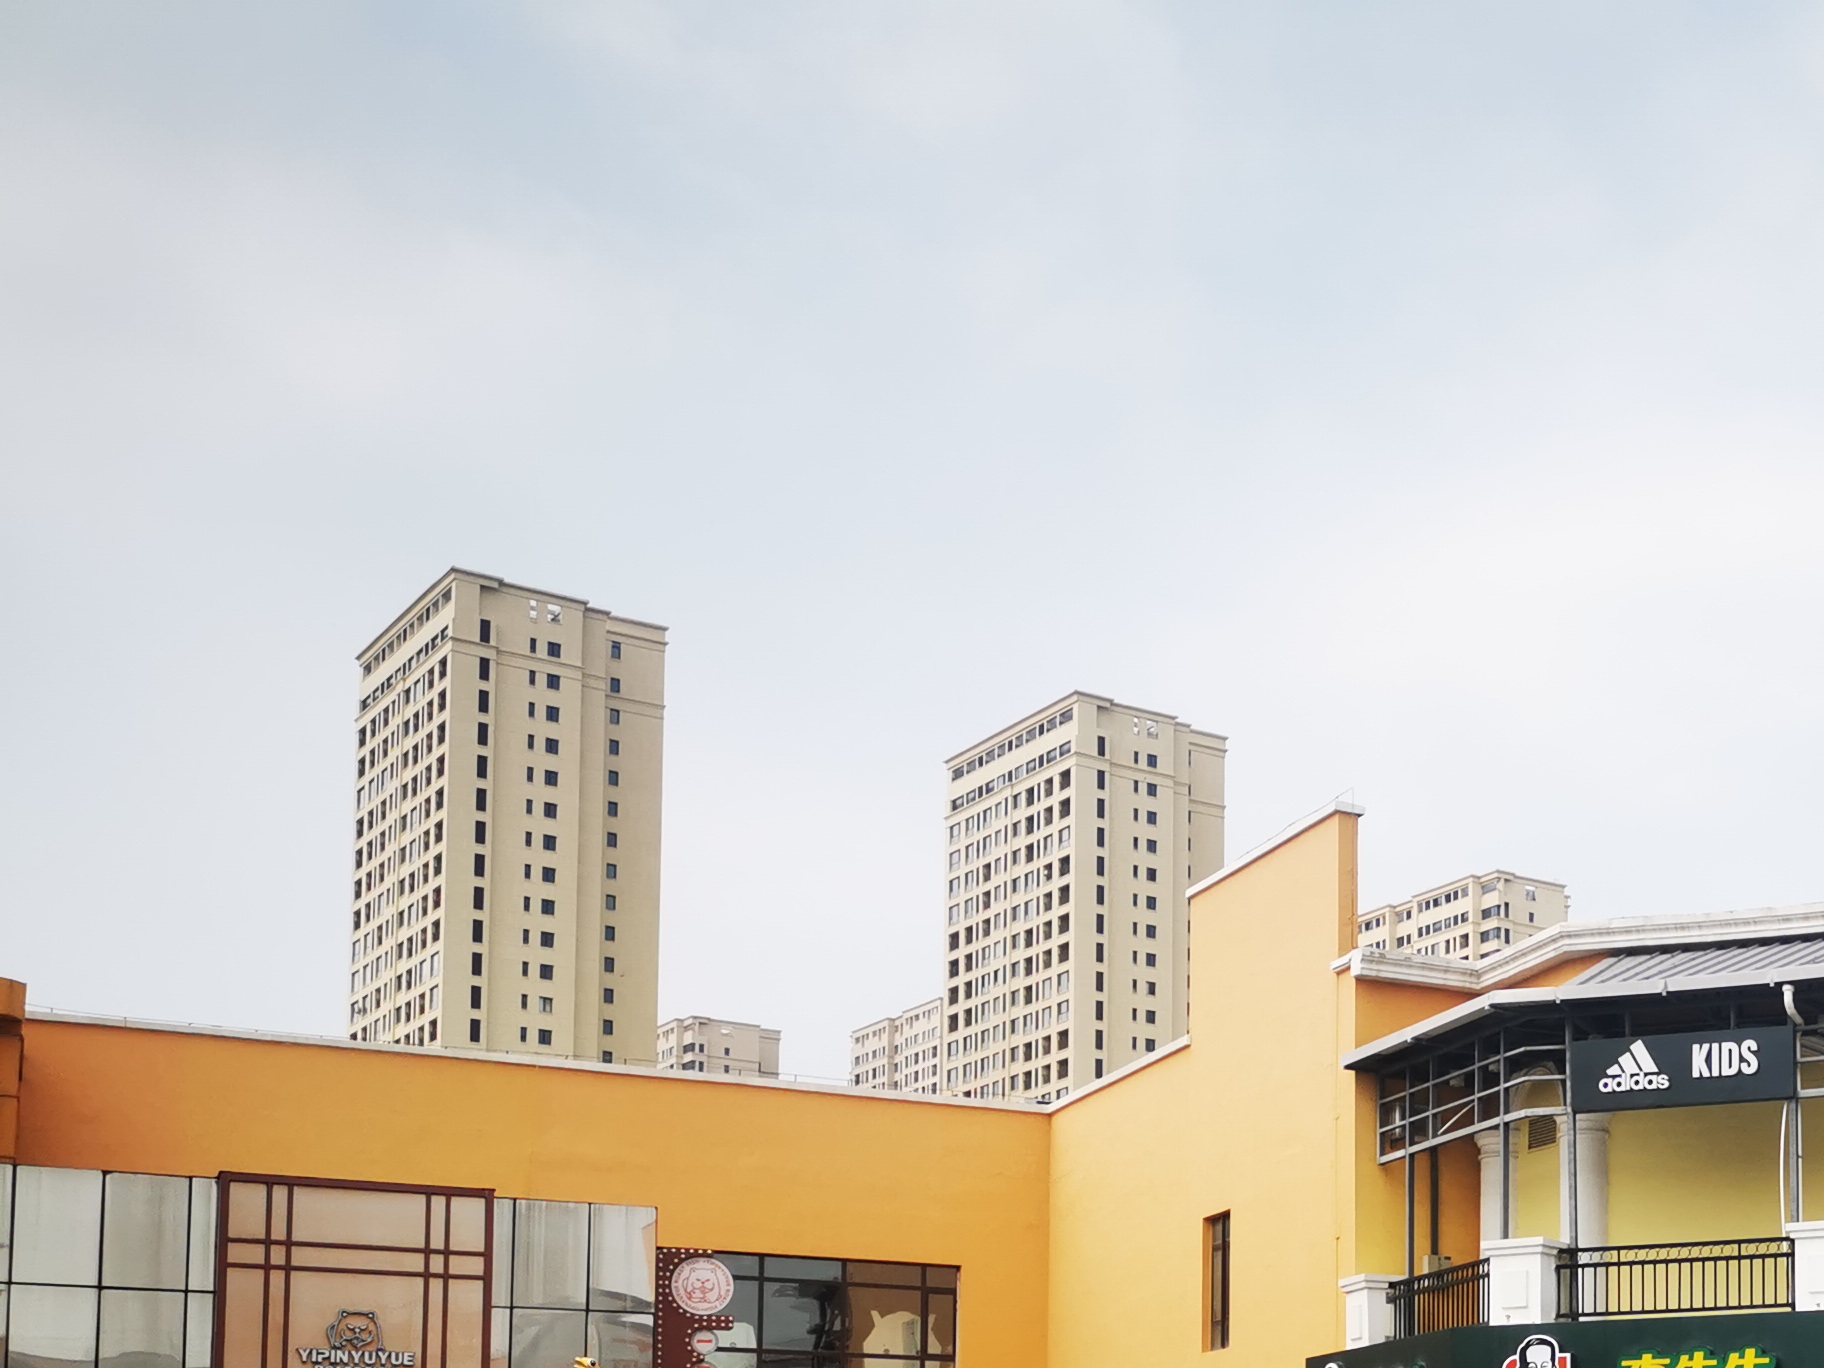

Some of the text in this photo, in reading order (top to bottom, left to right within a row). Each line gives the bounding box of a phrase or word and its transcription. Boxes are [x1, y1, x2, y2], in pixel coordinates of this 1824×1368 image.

[1599, 1039, 1759, 1093] adidas KIDS
[298, 1348, 416, 1366] YIPINYUYUE
